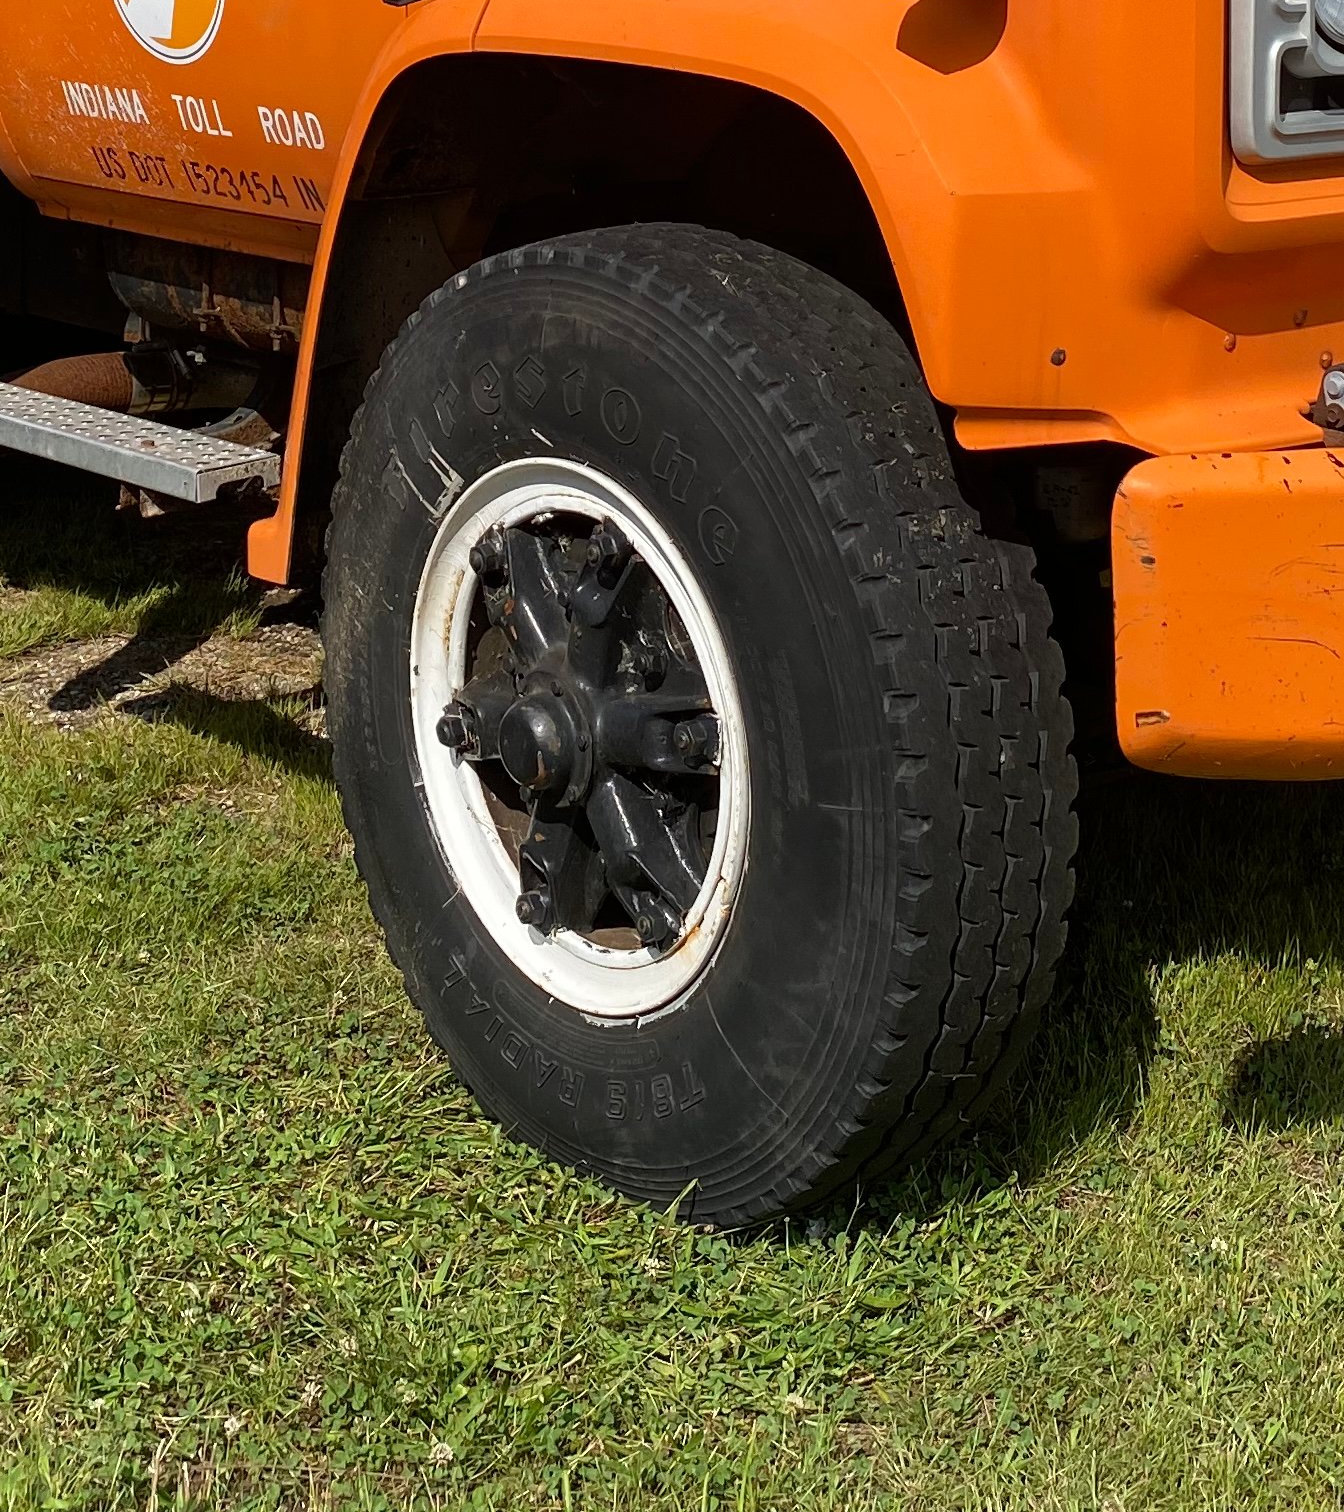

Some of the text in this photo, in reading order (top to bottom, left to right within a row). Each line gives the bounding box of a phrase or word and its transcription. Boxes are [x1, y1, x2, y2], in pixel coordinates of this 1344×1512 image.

[60, 80, 325, 150] INDIANA TOLL ROAD
[91, 146, 127, 180] US
[128, 150, 175, 188] DOT
[292, 175, 326, 212] IN
[443, 952, 587, 1108] RADIAL
